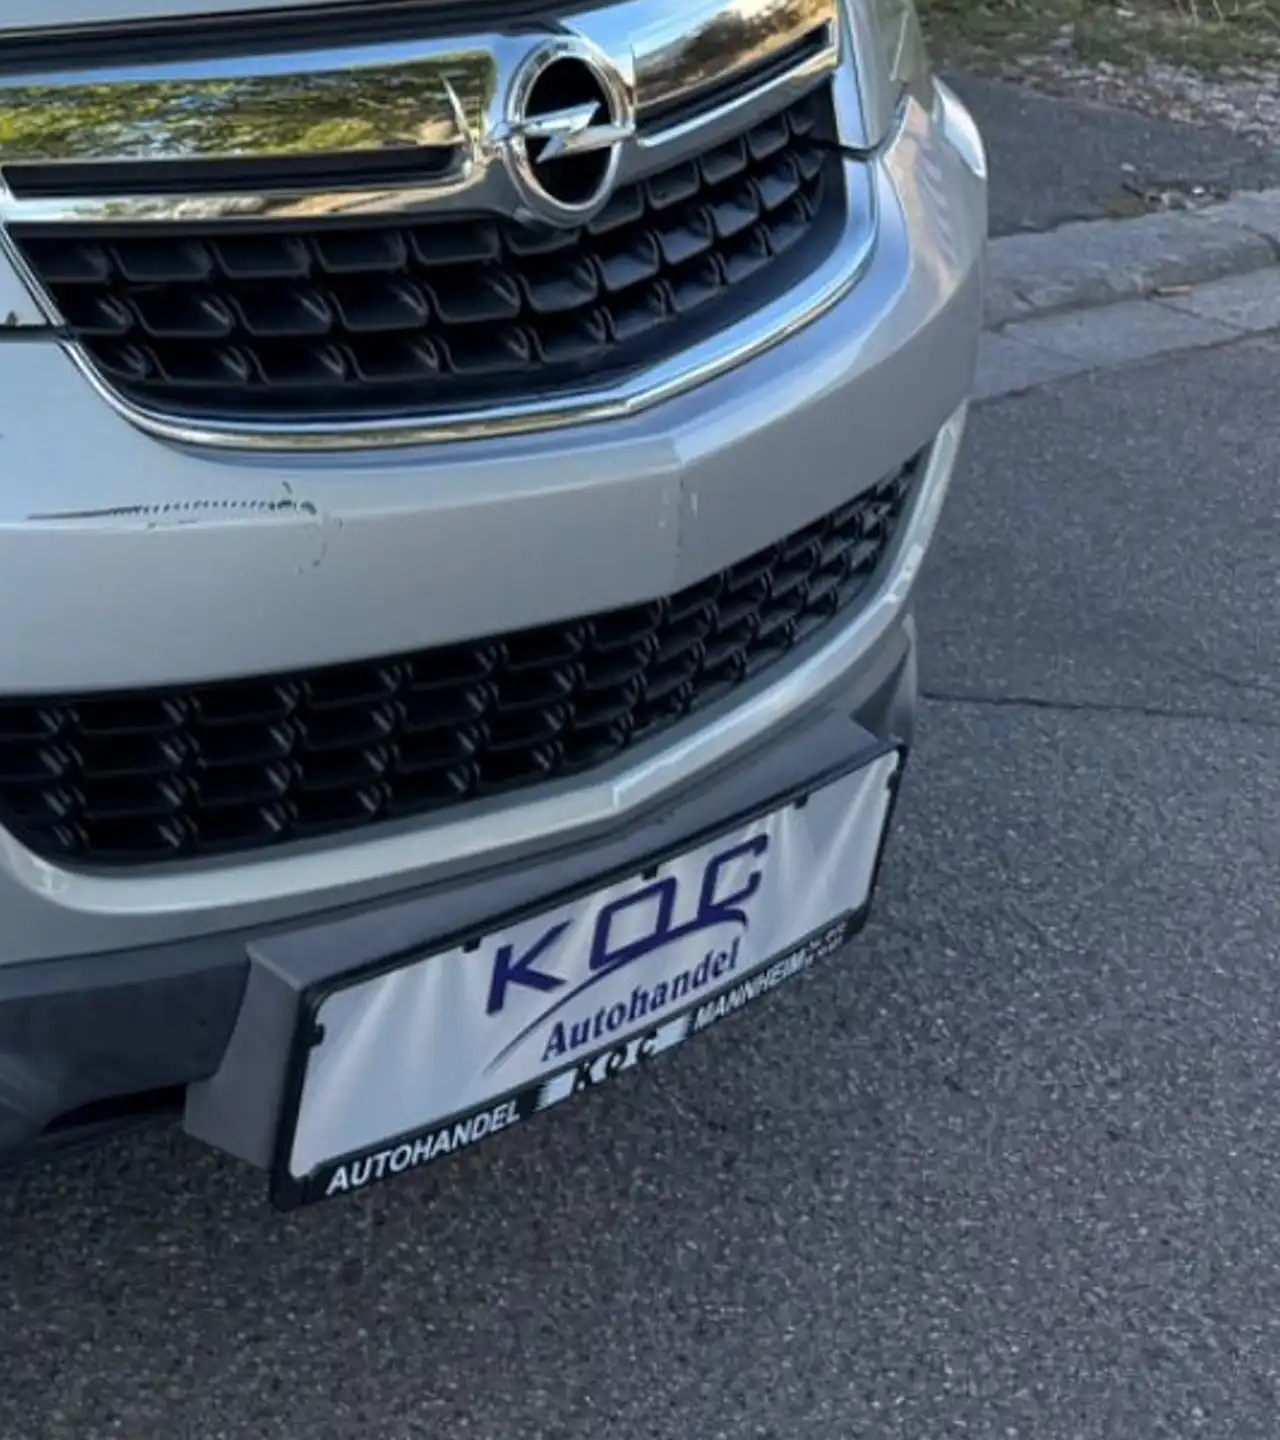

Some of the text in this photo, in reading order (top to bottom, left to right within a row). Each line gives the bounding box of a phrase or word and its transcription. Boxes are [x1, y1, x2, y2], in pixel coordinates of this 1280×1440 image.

[325, 1099, 520, 1196] AUTOHANDEL
[694, 947, 807, 1031] MANNHEIM
[541, 936, 740, 1062] Autohandel
